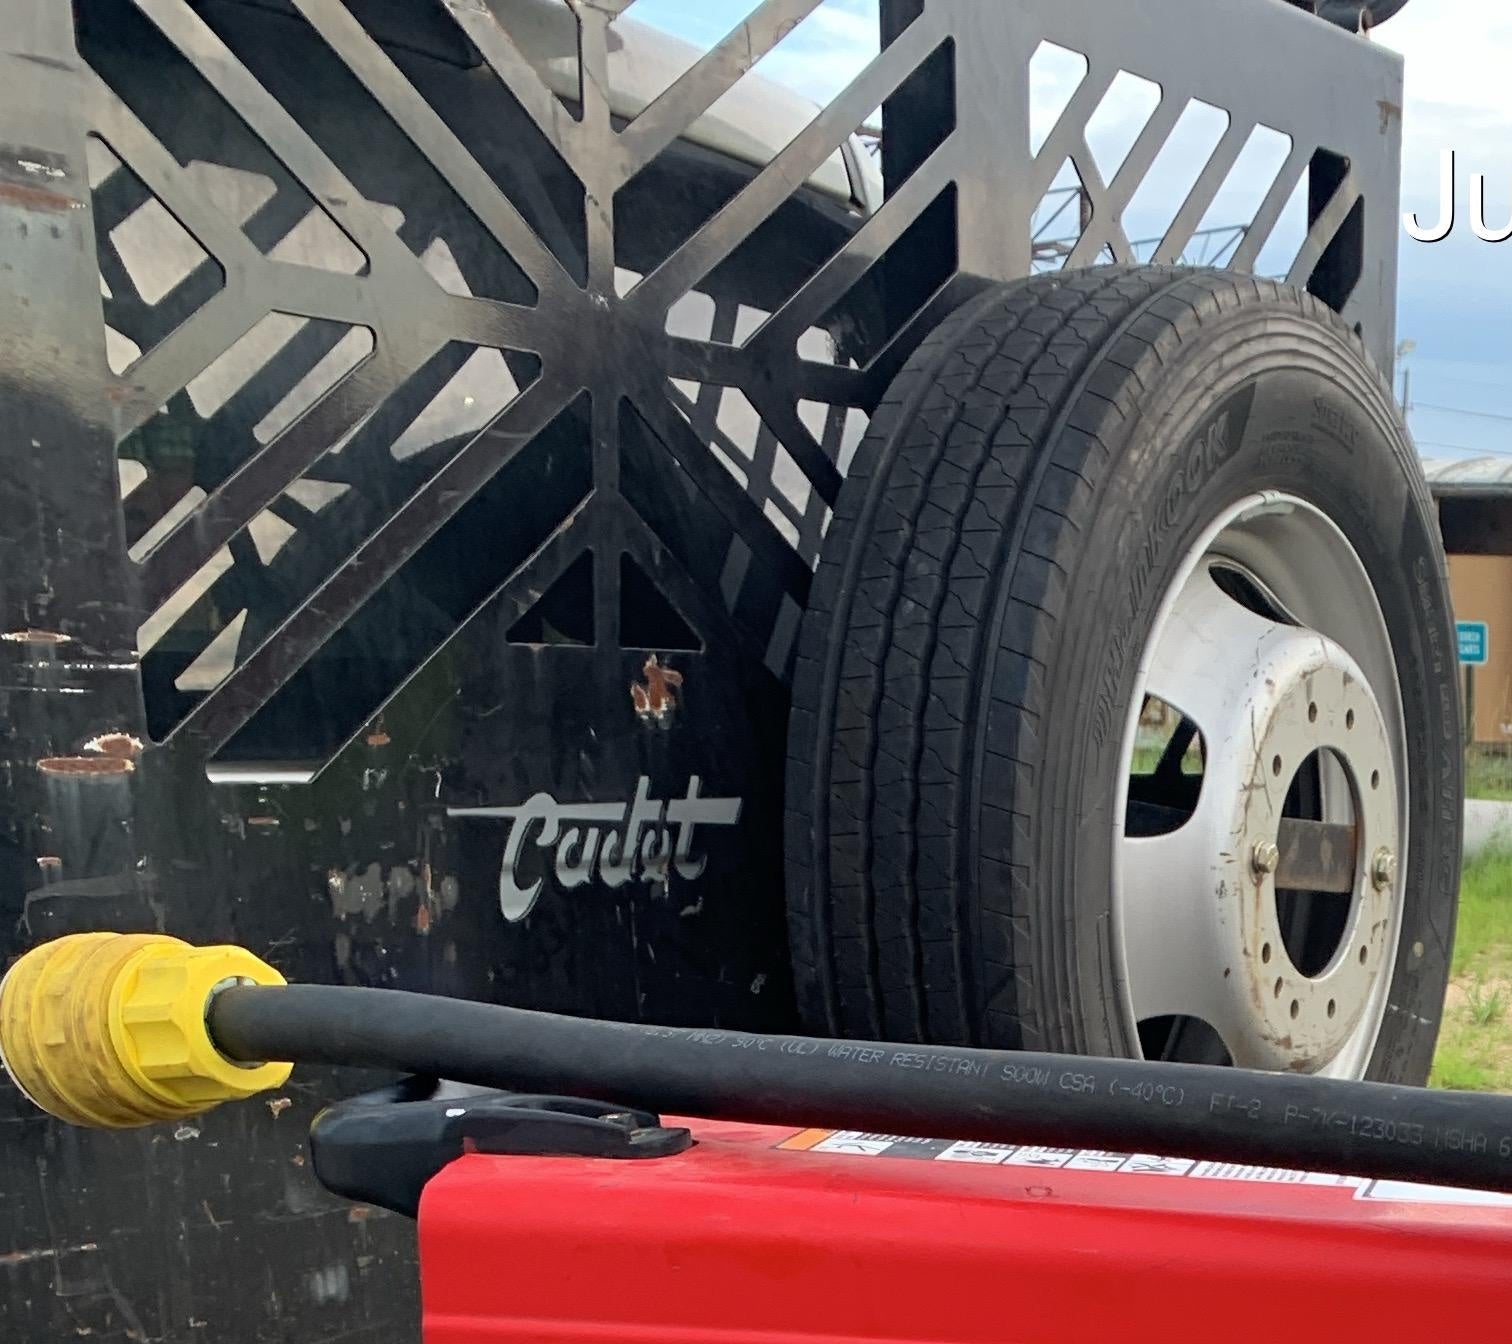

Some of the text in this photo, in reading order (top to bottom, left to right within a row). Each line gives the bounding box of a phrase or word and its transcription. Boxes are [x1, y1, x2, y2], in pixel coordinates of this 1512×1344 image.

[828, 1047, 885, 1064] WATER
[889, 1051, 990, 1078] RESISTANT
[1059, 1071, 1097, 1094] CSA
